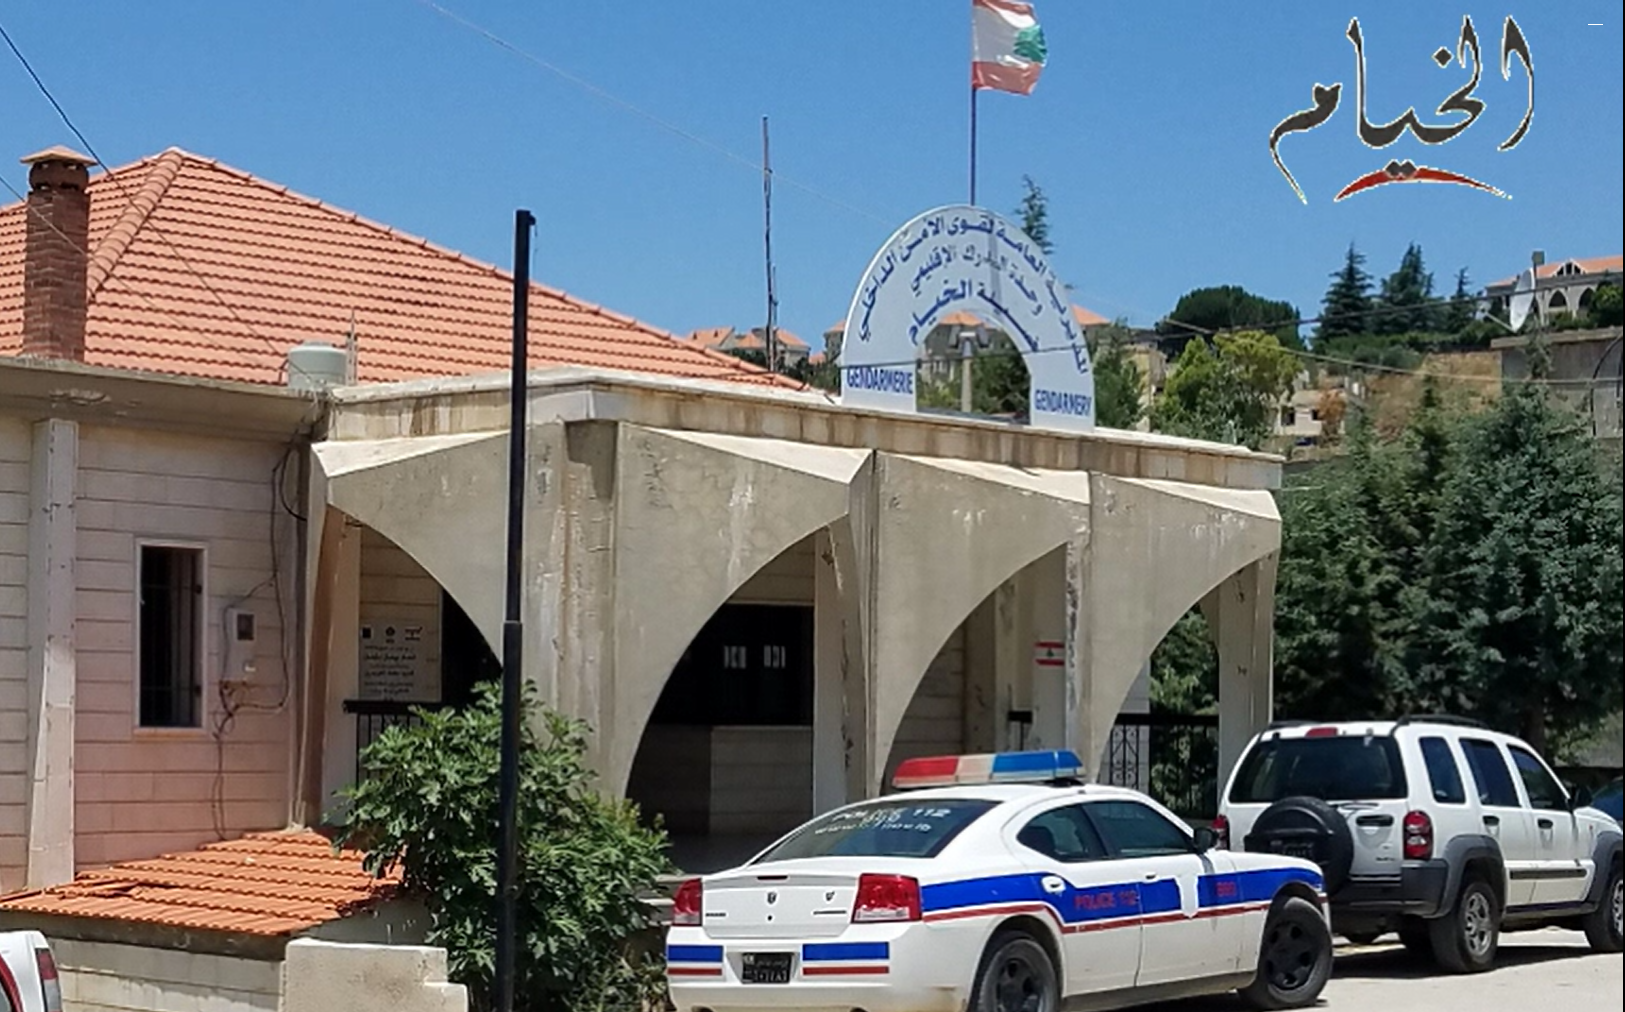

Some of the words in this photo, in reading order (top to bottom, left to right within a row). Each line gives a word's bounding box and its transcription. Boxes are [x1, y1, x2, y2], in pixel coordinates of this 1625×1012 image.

[947, 213, 995, 236] لقوى
[996, 220, 1048, 277] العامة
[859, 249, 898, 342] الداخلي
[1008, 262, 1043, 316] وحدة
[908, 279, 972, 347] الخيام
[847, 365, 915, 394] GENDARMERIE
[912, 807, 952, 819] 112
[1073, 892, 1117, 911] POLICE
